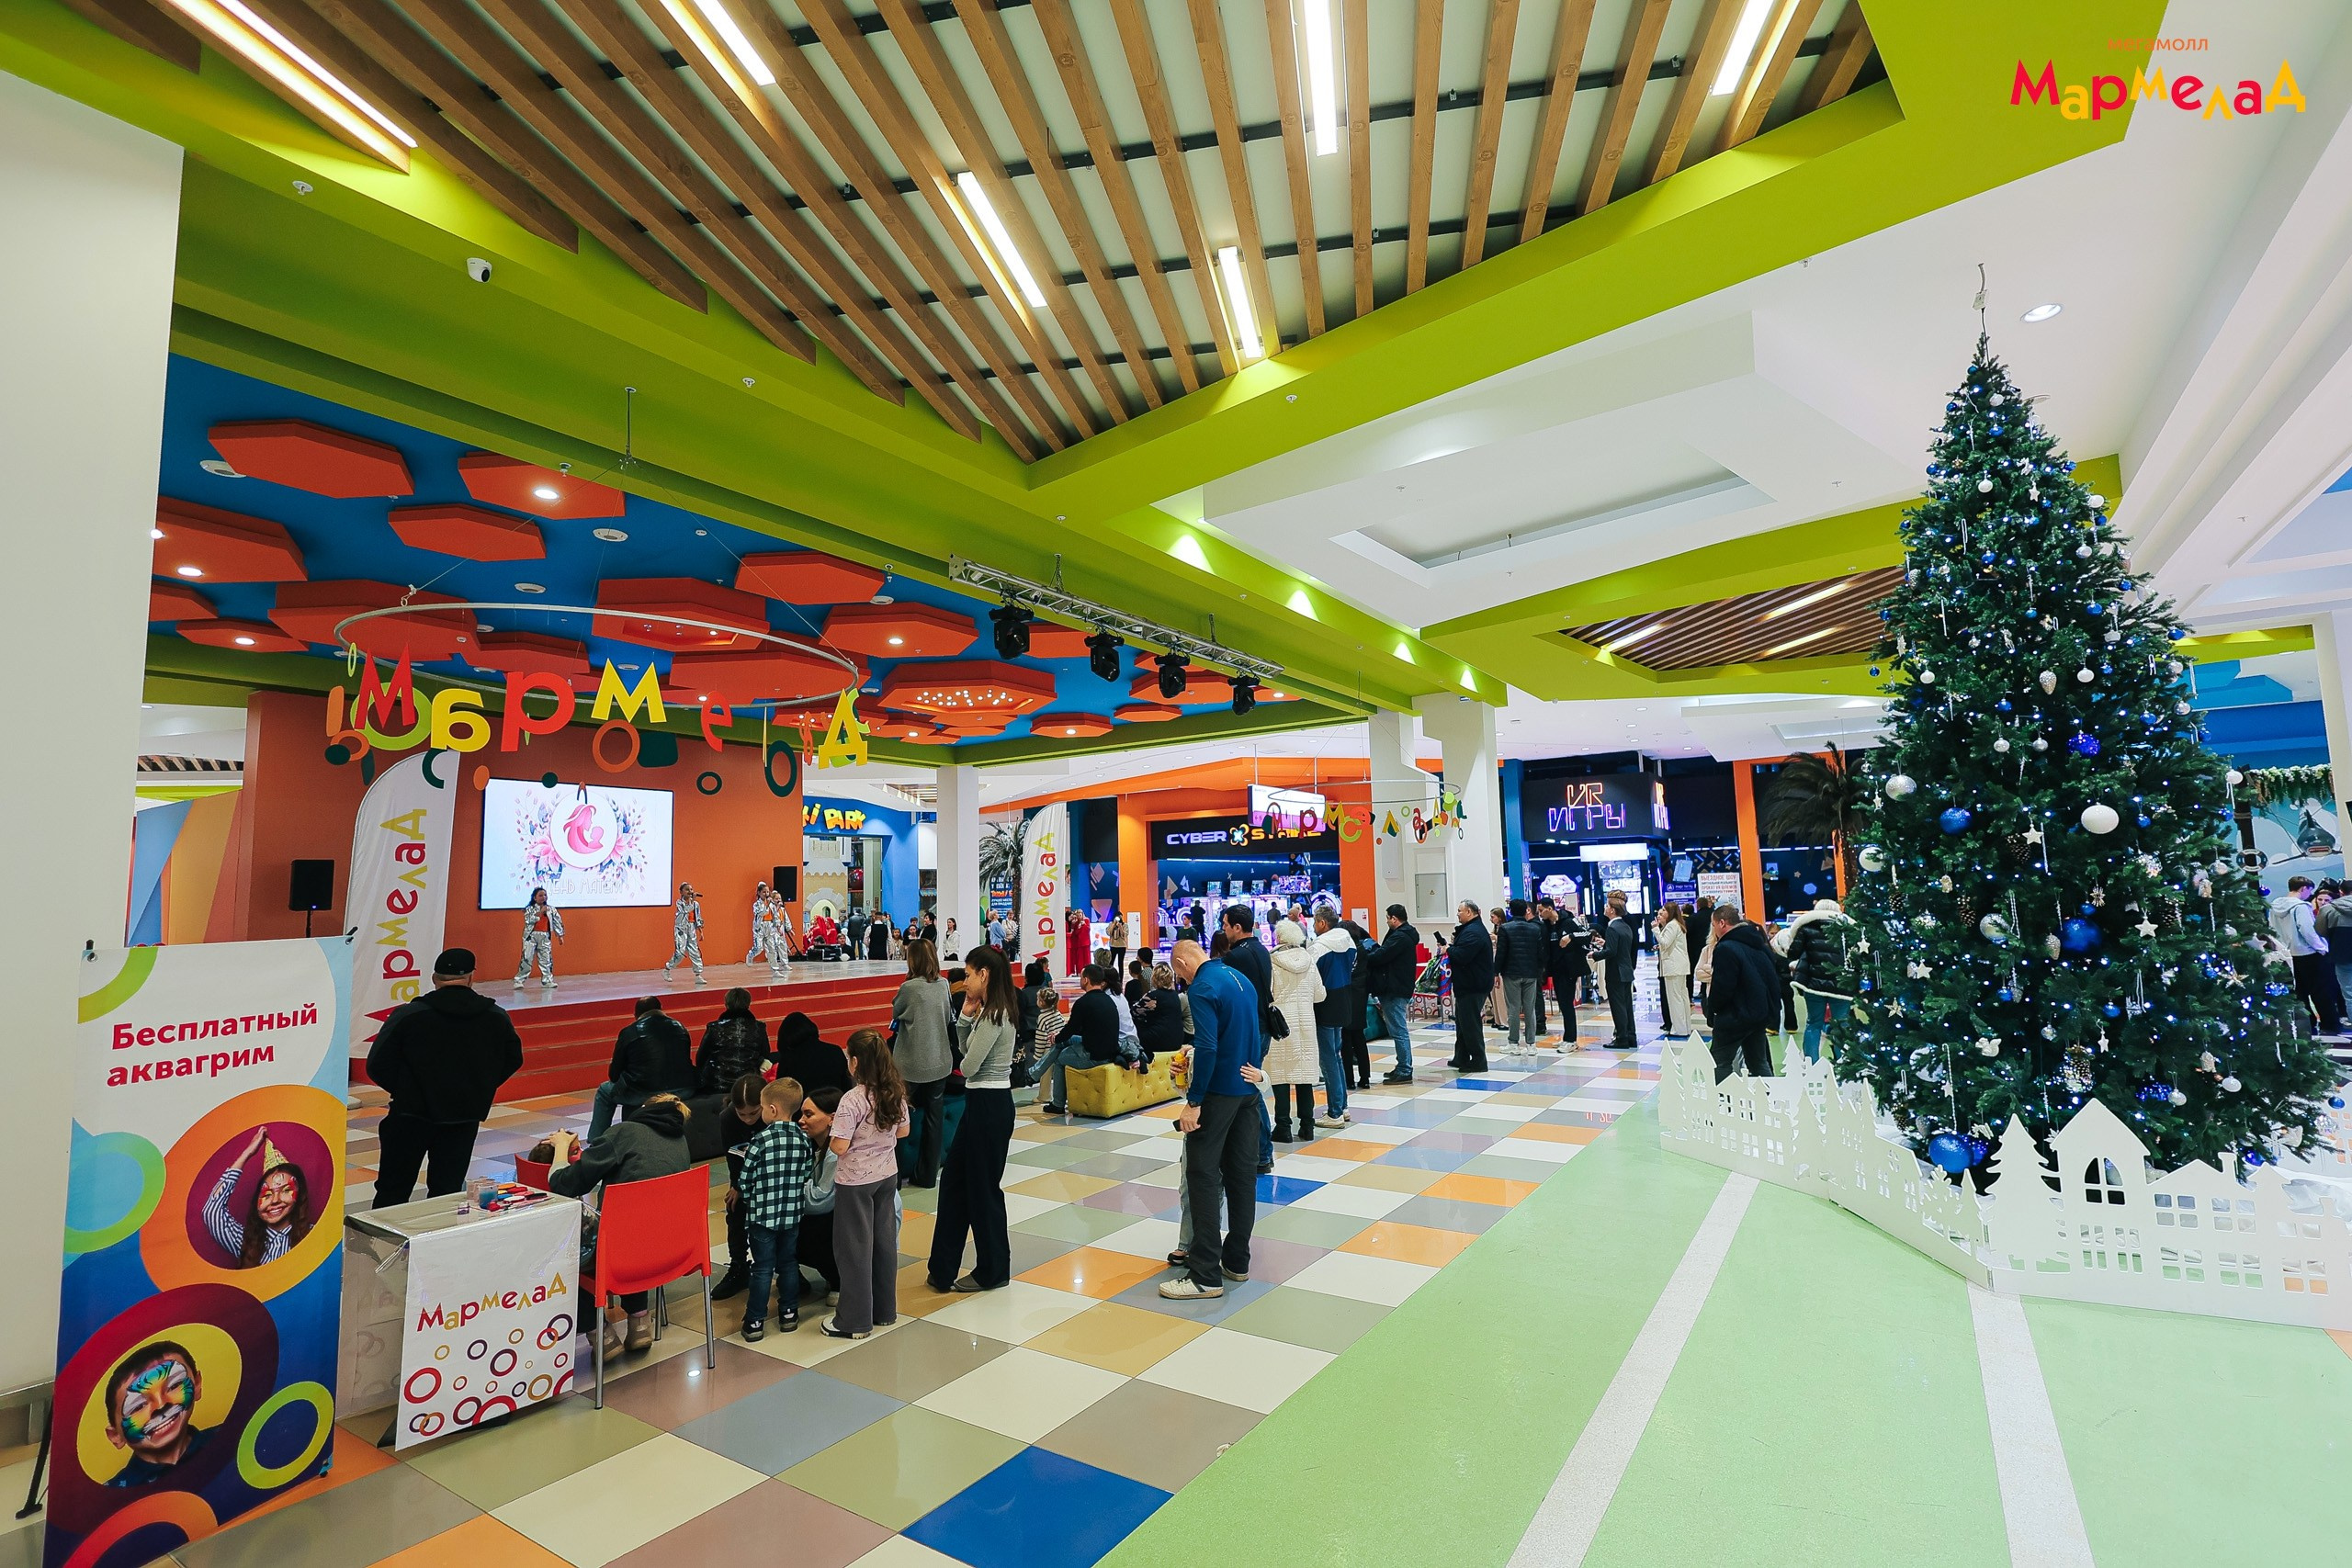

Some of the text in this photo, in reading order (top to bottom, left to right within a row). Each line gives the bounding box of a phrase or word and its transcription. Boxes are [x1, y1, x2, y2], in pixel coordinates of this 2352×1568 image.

[1166, 830, 1227, 845] CYBER
[111, 1002, 319, 1051] Бесплатный
[107, 1045, 275, 1088] аквагрим
